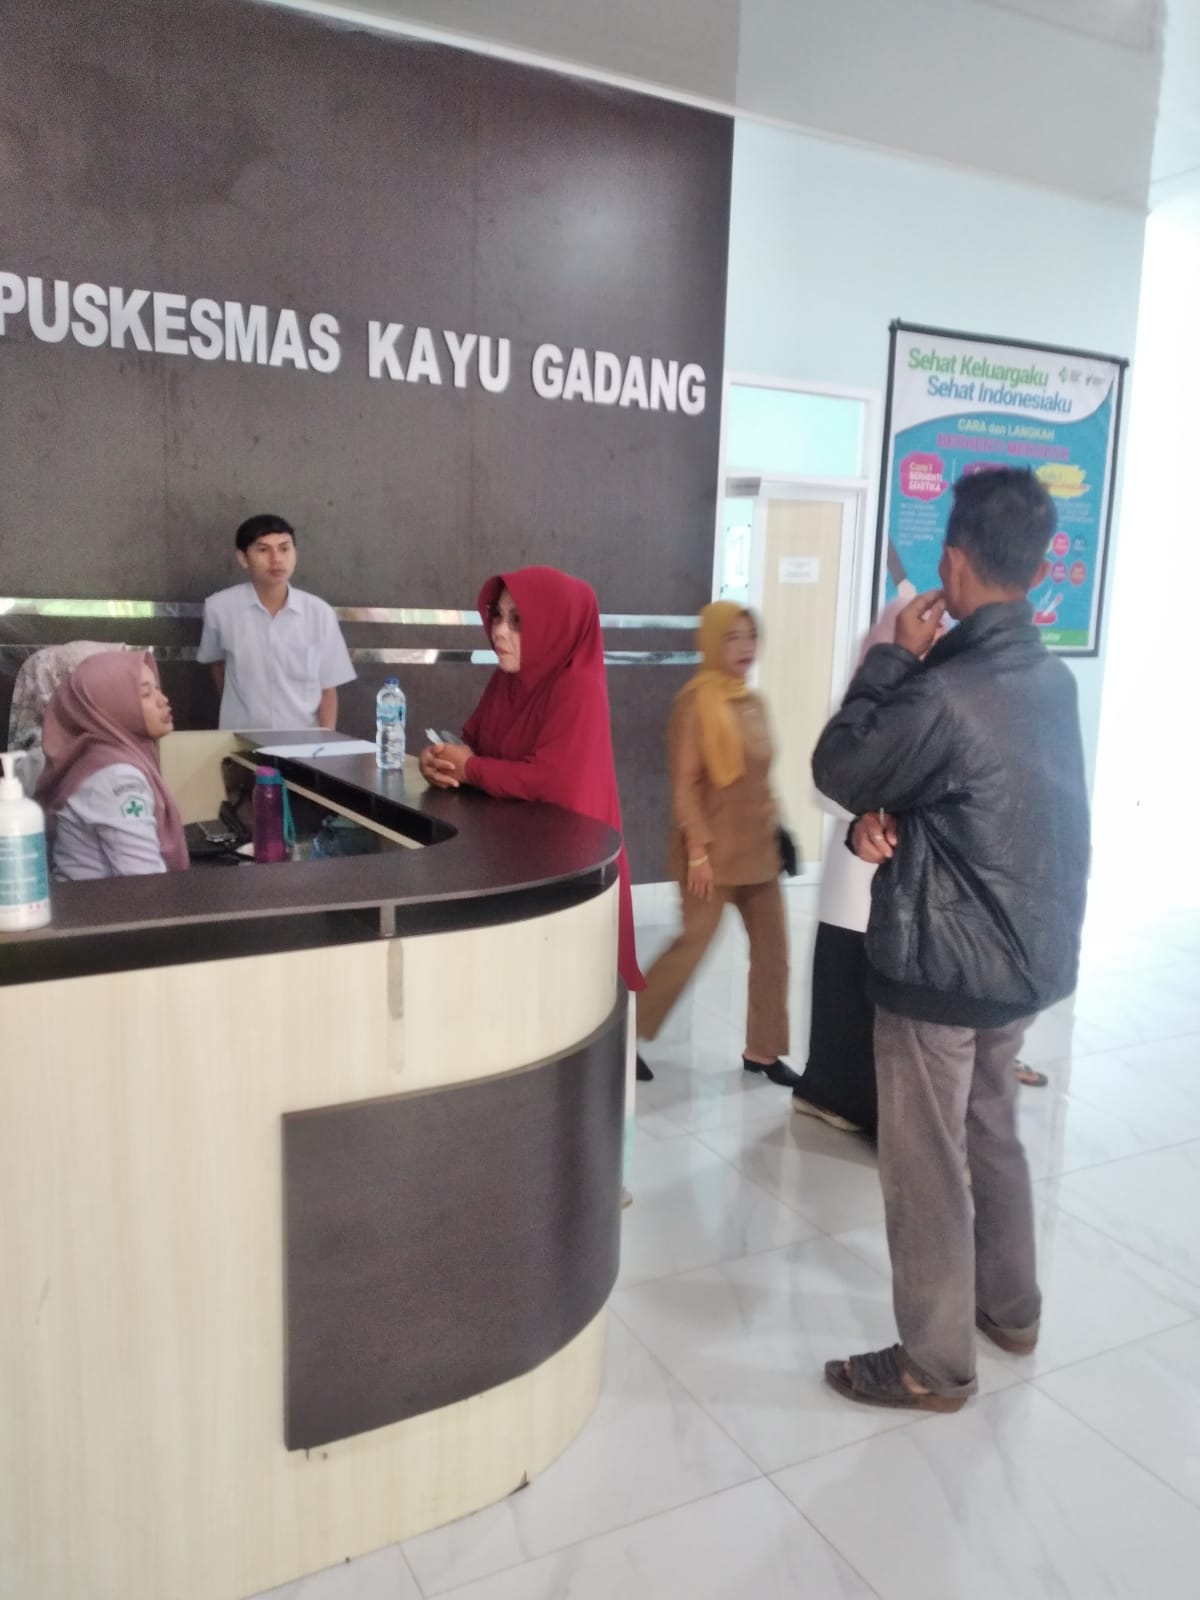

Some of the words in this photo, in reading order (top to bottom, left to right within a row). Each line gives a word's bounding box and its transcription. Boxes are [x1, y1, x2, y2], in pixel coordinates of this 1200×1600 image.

[0, 271, 341, 374] PUSKESMAS
[368, 320, 510, 393] KAYU
[532, 343, 706, 416] GADANG
[908, 347, 957, 374] Sehat
[960, 354, 1049, 388] Keluargaku
[927, 375, 975, 401] Sehat
[978, 385, 1072, 414] Indonesiaku
[958, 418, 987, 432] CARA
[1008, 425, 1055, 440] LANGKAH
